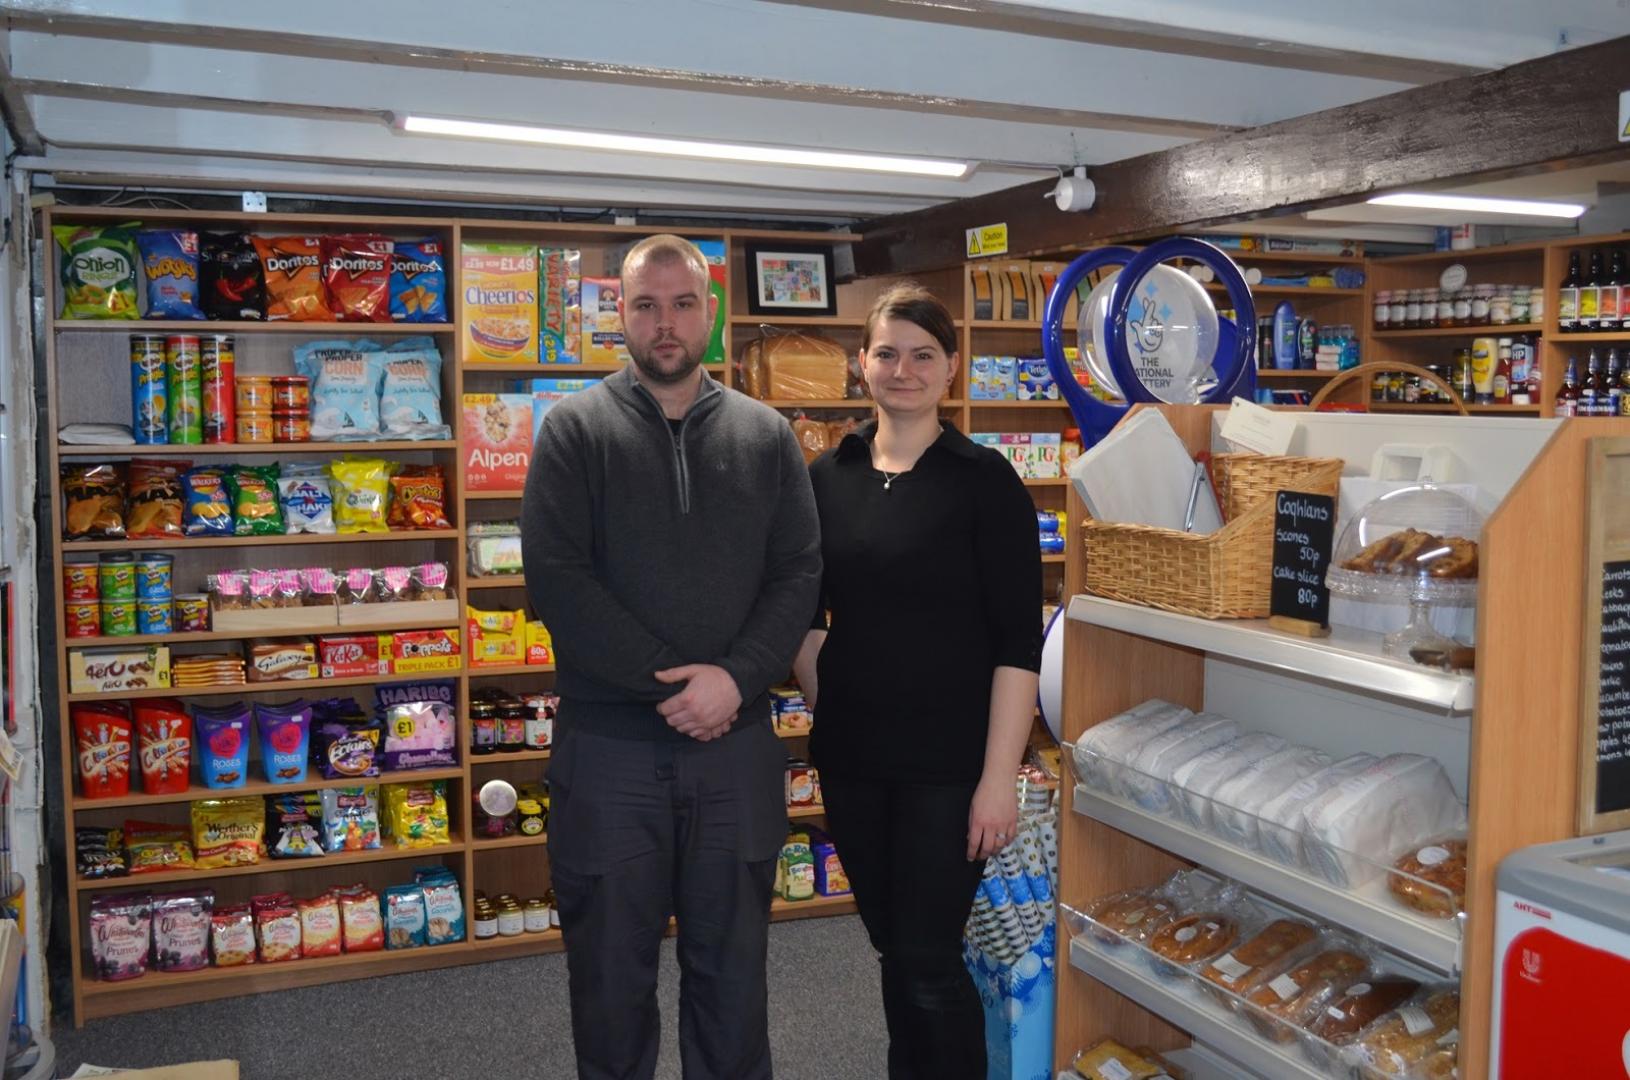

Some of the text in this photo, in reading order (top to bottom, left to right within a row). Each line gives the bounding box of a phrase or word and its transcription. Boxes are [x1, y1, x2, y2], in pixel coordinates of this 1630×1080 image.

[267, 255, 318, 272] Doritos
[332, 257, 384, 271] Doritos
[501, 257, 534, 272] £1.49
[466, 286, 534, 305] Cheerios
[1141, 357, 1159, 367] THE
[1512, 350, 1525, 360] HP
[325, 361, 364, 375] CORN
[1135, 368, 1174, 378] ATIONAL
[1142, 379, 1172, 388] TTERY
[468, 448, 529, 471] Alpen
[1008, 447, 1023, 462] PG
[1038, 447, 1053, 462] PG
[1300, 547, 1320, 569] 50p
[1274, 565, 1320, 586] cake slice
[1297, 589, 1318, 609] 80p
[1602, 586, 1624, 599] eeks
[158, 670, 168, 681] £1
[380, 686, 452, 705] HARIBO
[398, 721, 412, 734] £1
